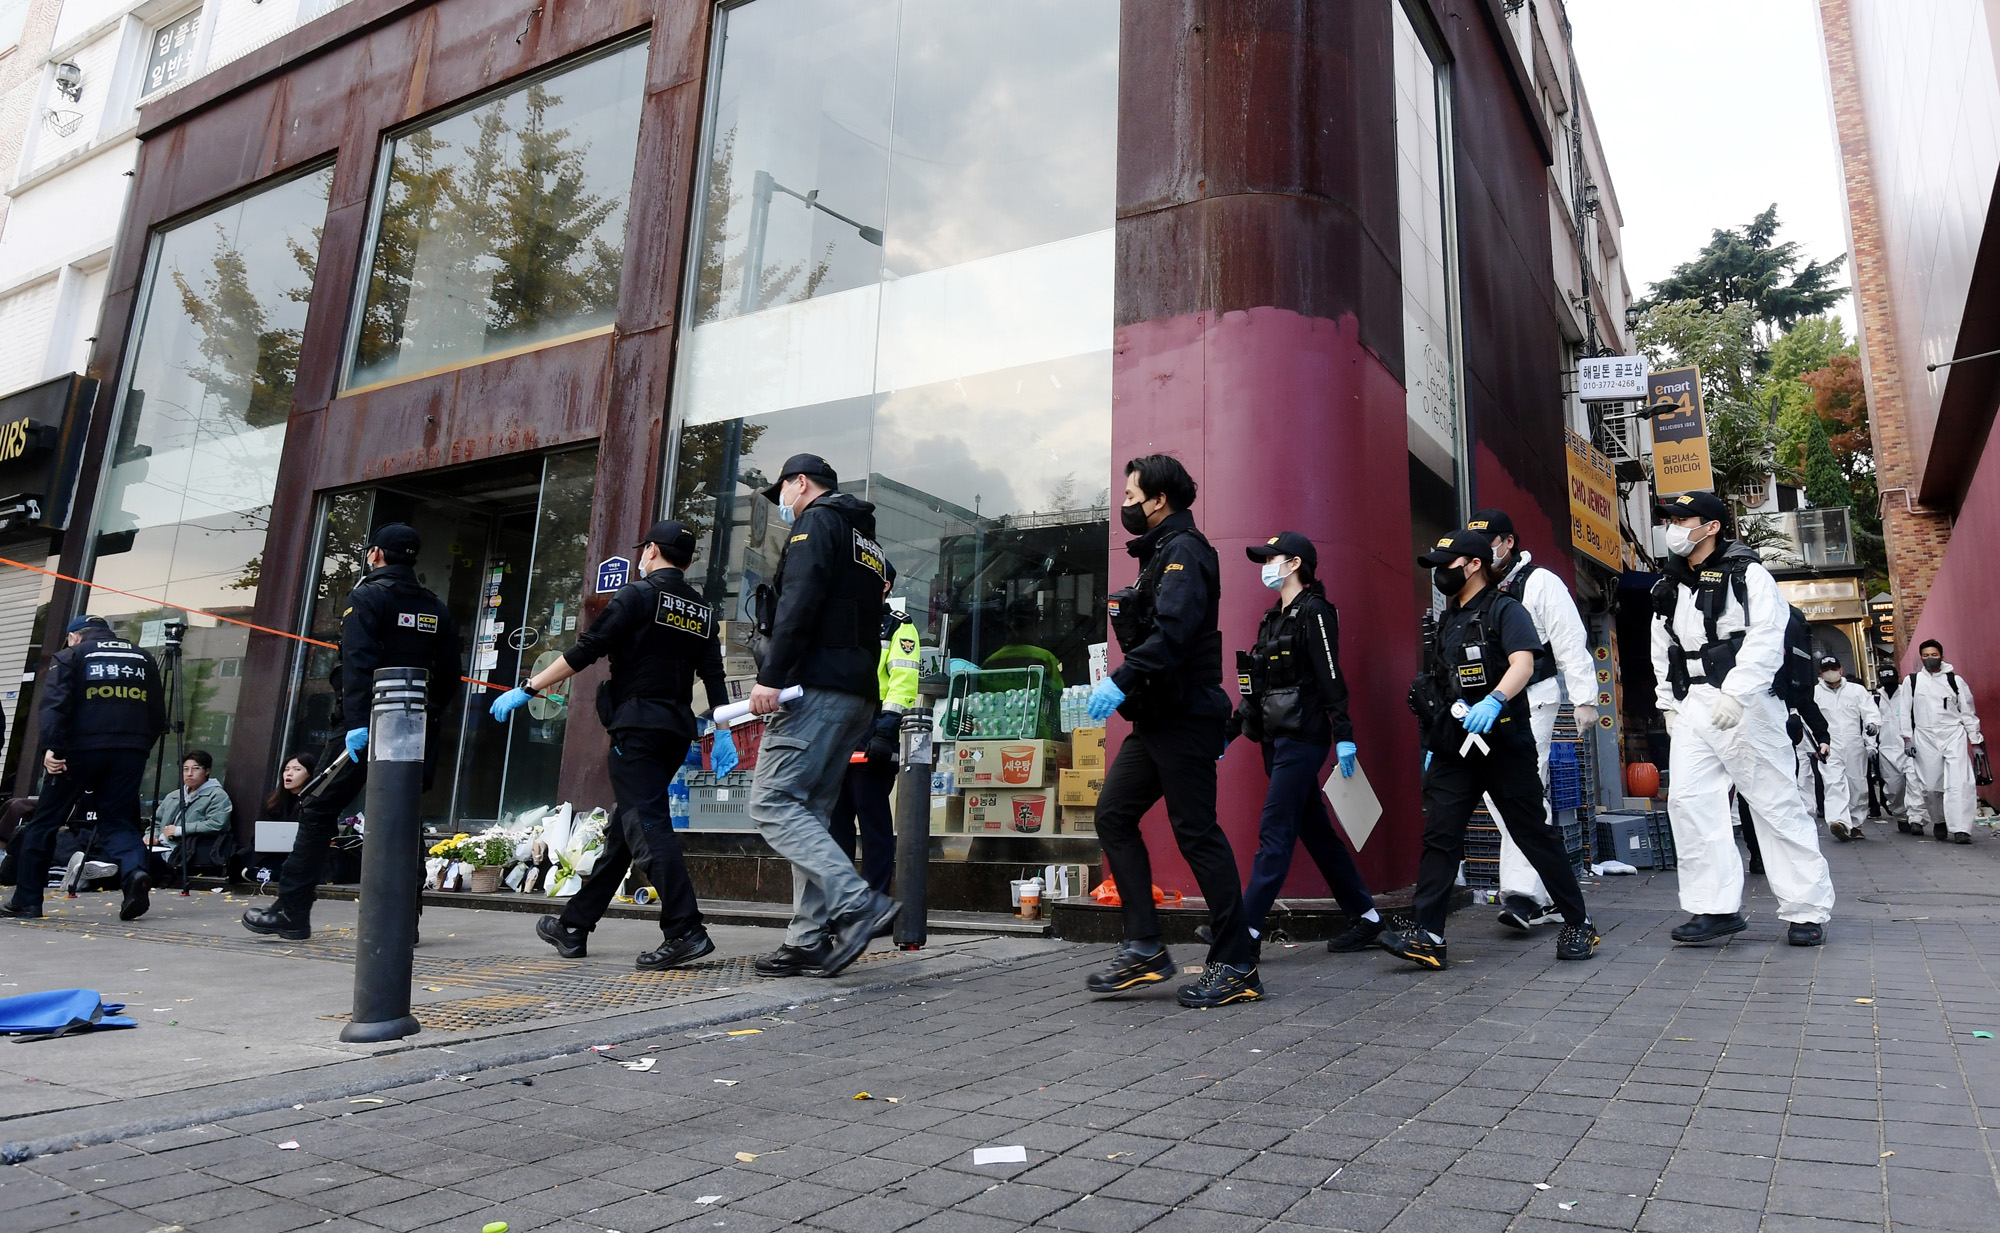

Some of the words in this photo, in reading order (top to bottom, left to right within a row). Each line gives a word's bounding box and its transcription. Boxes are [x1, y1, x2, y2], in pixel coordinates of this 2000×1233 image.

[1583, 364, 1610, 379] 해밀톤
[1615, 362, 1642, 378] 골프샵
[1584, 380, 1635, 390] 010-3772-4268
[1655, 381, 1690, 395] emart
[1662, 452, 1700, 464] 딜리셔스
[1664, 462, 1700, 474] 아이디어
[1572, 474, 1586, 506] CHO
[604, 574, 622, 588] 173
[662, 596, 708, 622] 과학수사
[666, 613, 702, 632] POLICE
[97, 641, 132, 650] KCSI
[90, 664, 146, 680] 과학수사
[1460, 667, 1482, 676] KCSI
[86, 686, 147, 702] POLICE
[1004, 760, 1031, 772] 새우탕
